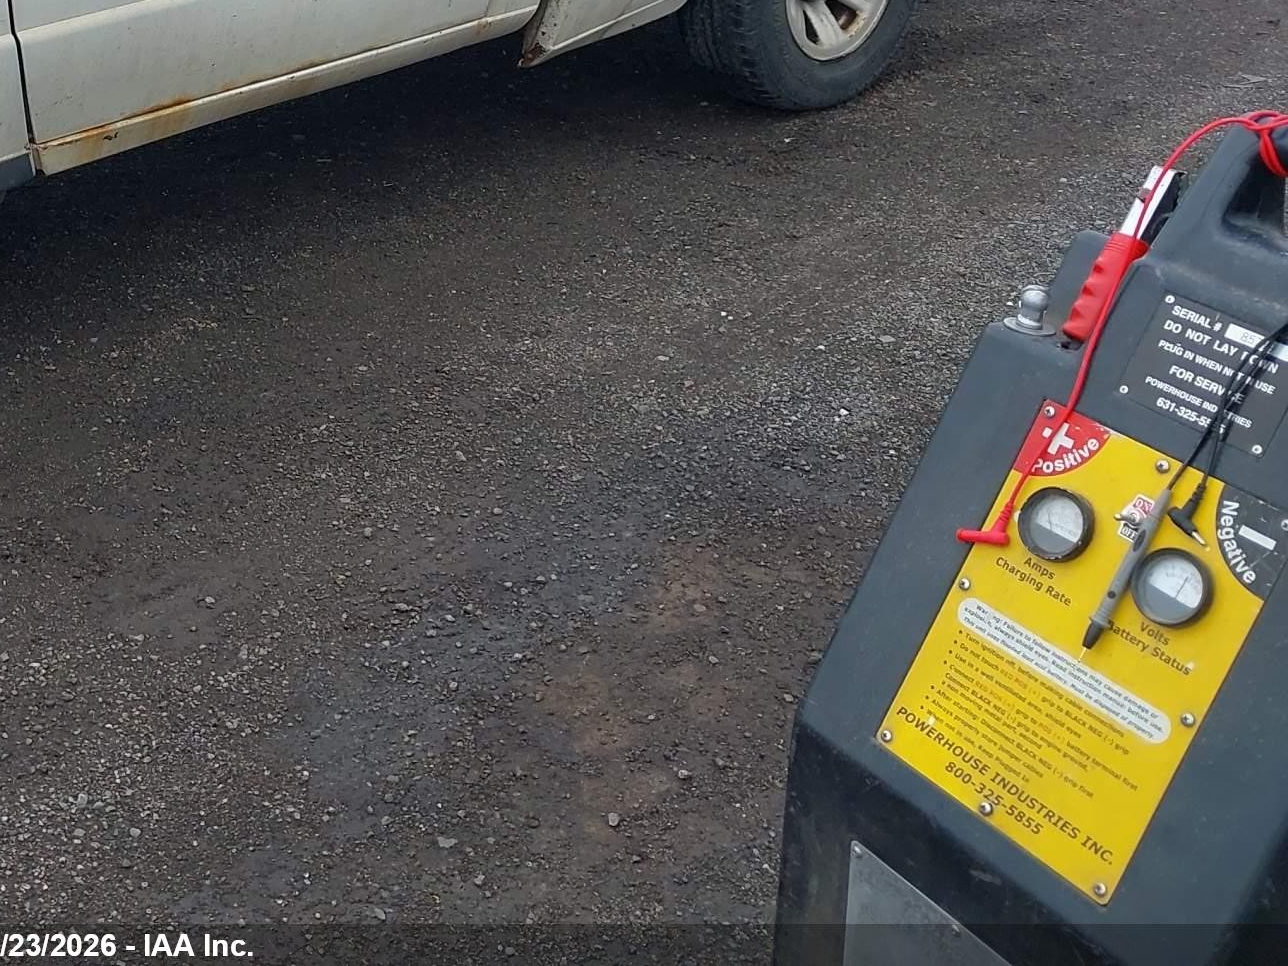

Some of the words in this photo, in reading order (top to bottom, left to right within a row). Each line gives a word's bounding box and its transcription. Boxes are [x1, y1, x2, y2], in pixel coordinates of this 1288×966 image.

[1171, 305, 1212, 328] SERIAL
[1164, 320, 1182, 334] DO
[1185, 328, 1212, 346] NOT
[1213, 340, 1238, 356] LAY
[1158, 339, 1184, 356] PLUG
[1183, 350, 1194, 361] IN
[1195, 354, 1223, 372] WHEN
[1255, 379, 1276, 395] USE
[1169, 365, 1195, 384] FOR
[1194, 376, 1245, 404] SERVE
[1145, 376, 1203, 407] POWERHOUSE
[1202, 402, 1252, 428] INDTRIES
[1031, 438, 1100, 473] Positive
[1217, 500, 1256, 584] Negative
[995, 556, 1044, 592] Charging
[1046, 585, 1072, 607] Rate
[1023, 557, 1057, 580] Amps
[1140, 621, 1171, 646] Volts
[1151, 643, 1193, 677] Status
[896, 706, 991, 776] POWERHOUSE
[990, 772, 1081, 840] INDUSTRIES
[1081, 836, 1114, 866] INC.
[945, 761, 1044, 835] 800-325-5855
